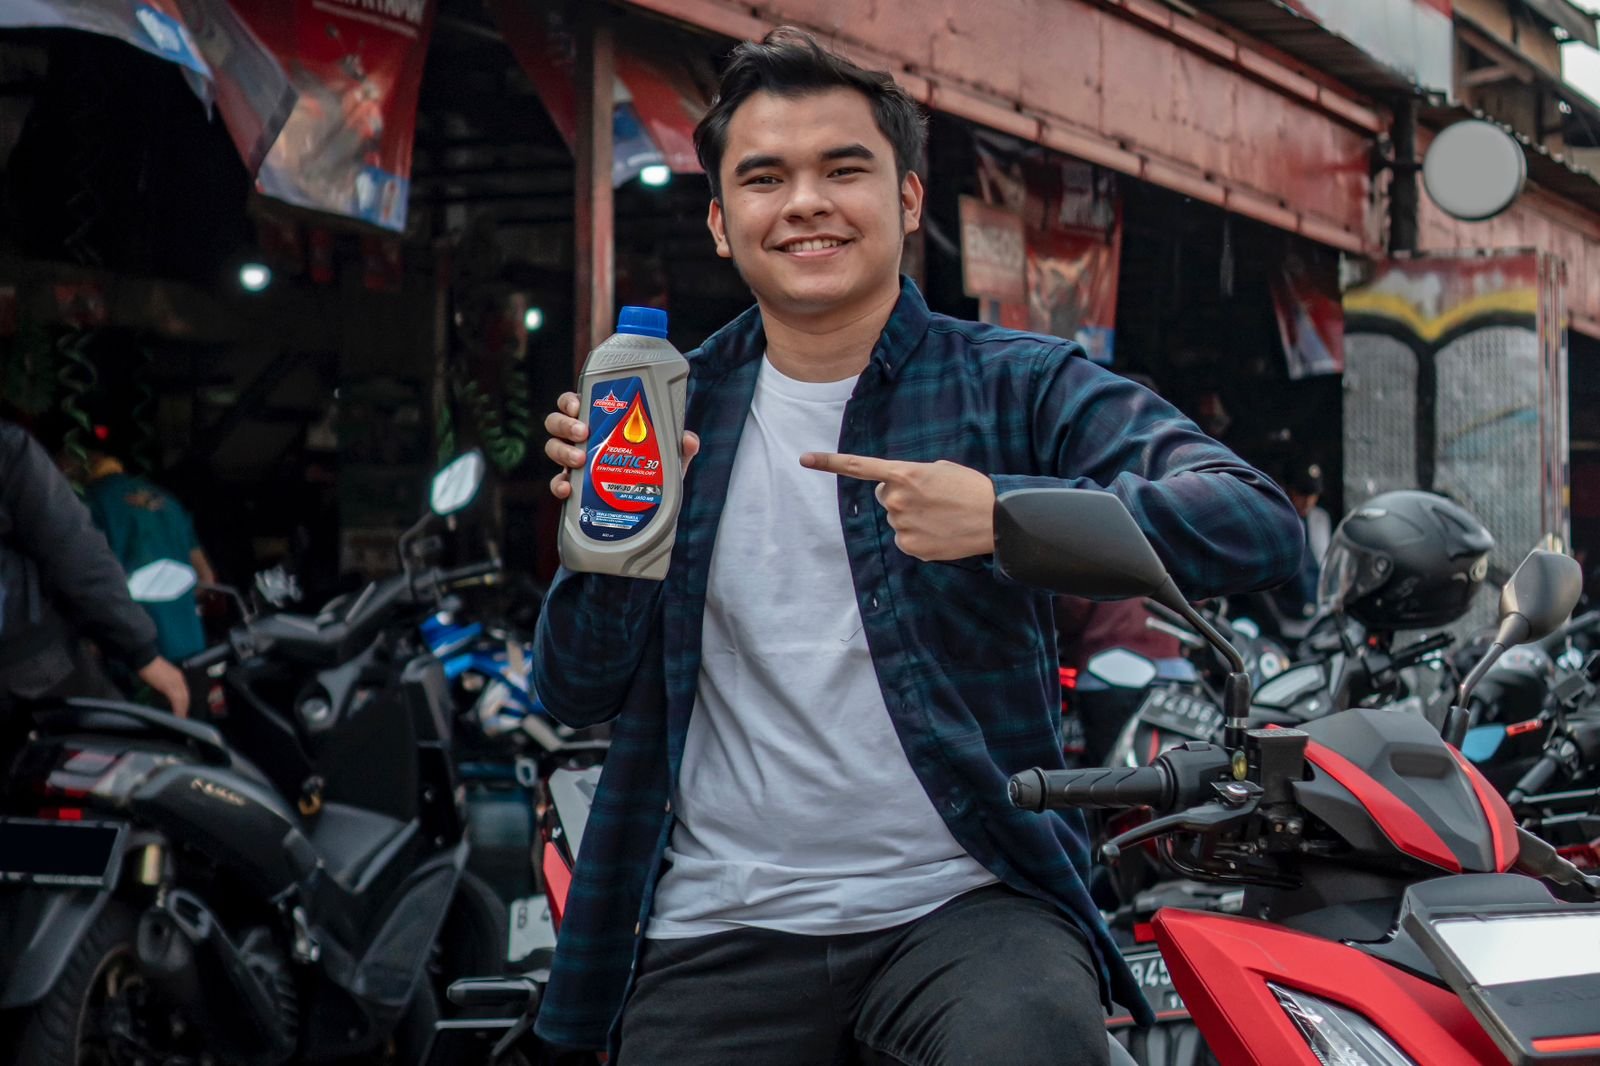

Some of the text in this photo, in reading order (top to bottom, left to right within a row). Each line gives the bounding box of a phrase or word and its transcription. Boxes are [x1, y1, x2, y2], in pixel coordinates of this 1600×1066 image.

[600, 454, 659, 470] MATIC 30
[623, 468, 657, 476] TECHNOLOGY
[607, 483, 631, 491] 10W-30
